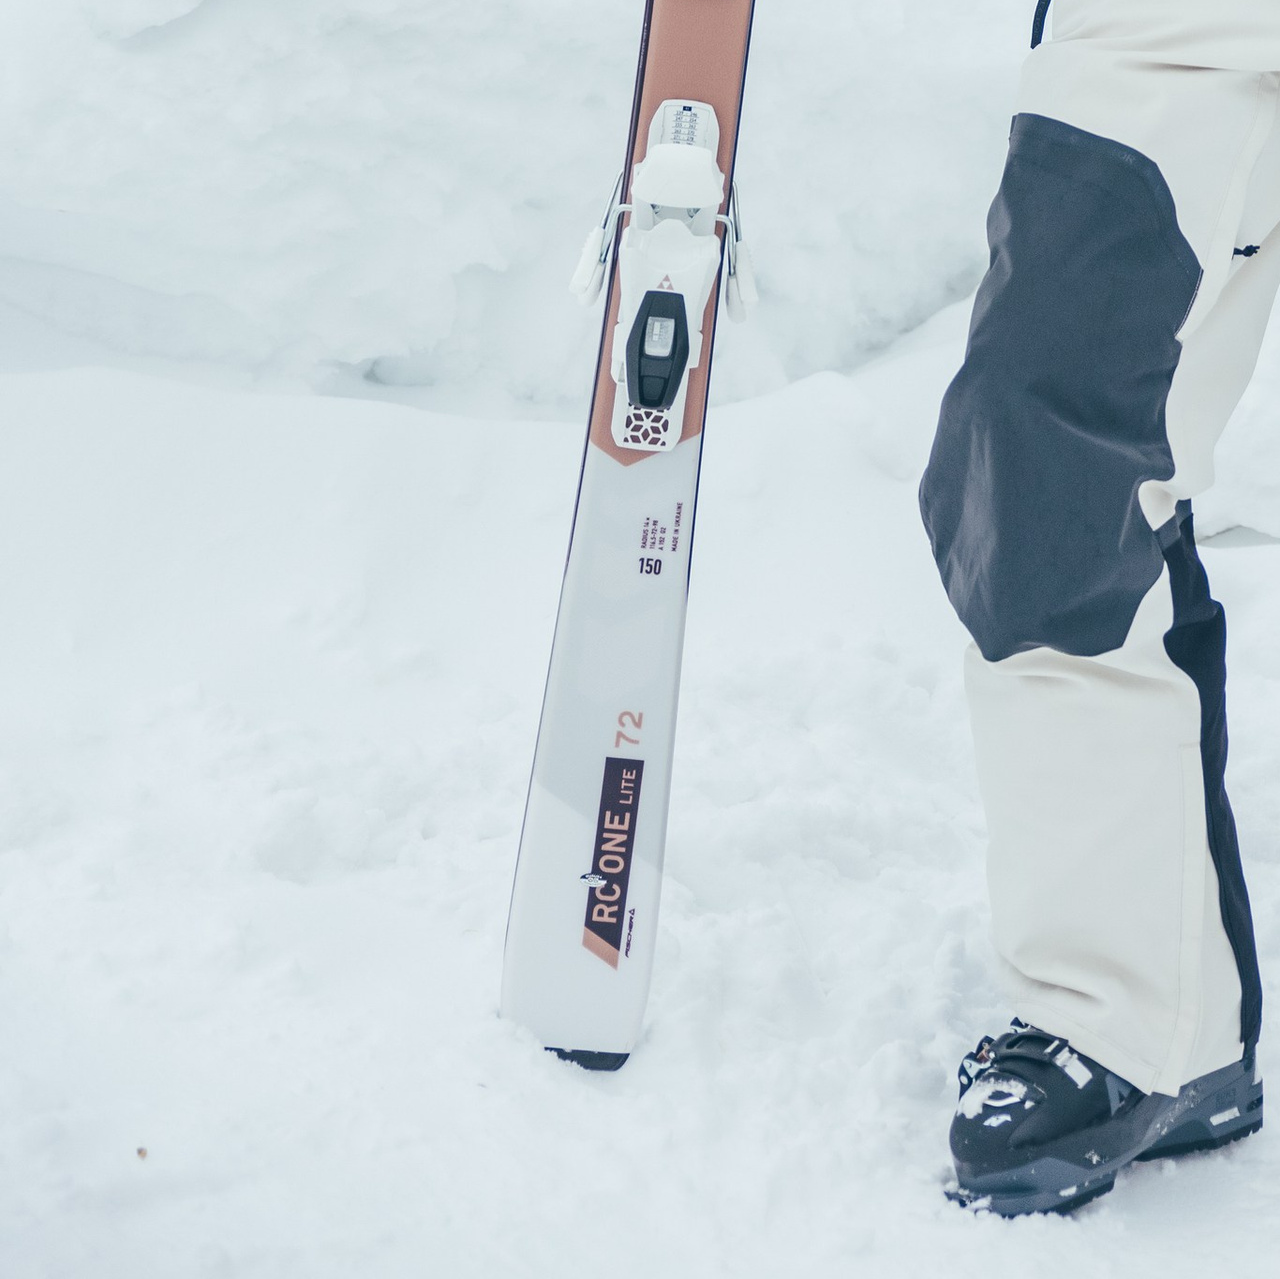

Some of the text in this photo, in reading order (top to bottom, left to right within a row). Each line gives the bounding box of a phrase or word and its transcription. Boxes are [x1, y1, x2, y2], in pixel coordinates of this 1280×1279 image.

[641, 529, 649, 549] RADIUS
[671, 536, 679, 552] MADE
[675, 502, 683, 527] UKRAINE
[639, 557, 662, 576] 150
[615, 710, 643, 749] 72
[619, 769, 637, 805] LITE
[599, 810, 631, 874] ONE
[592, 883, 621, 924] RC
[625, 916, 635, 958] FISCHER
